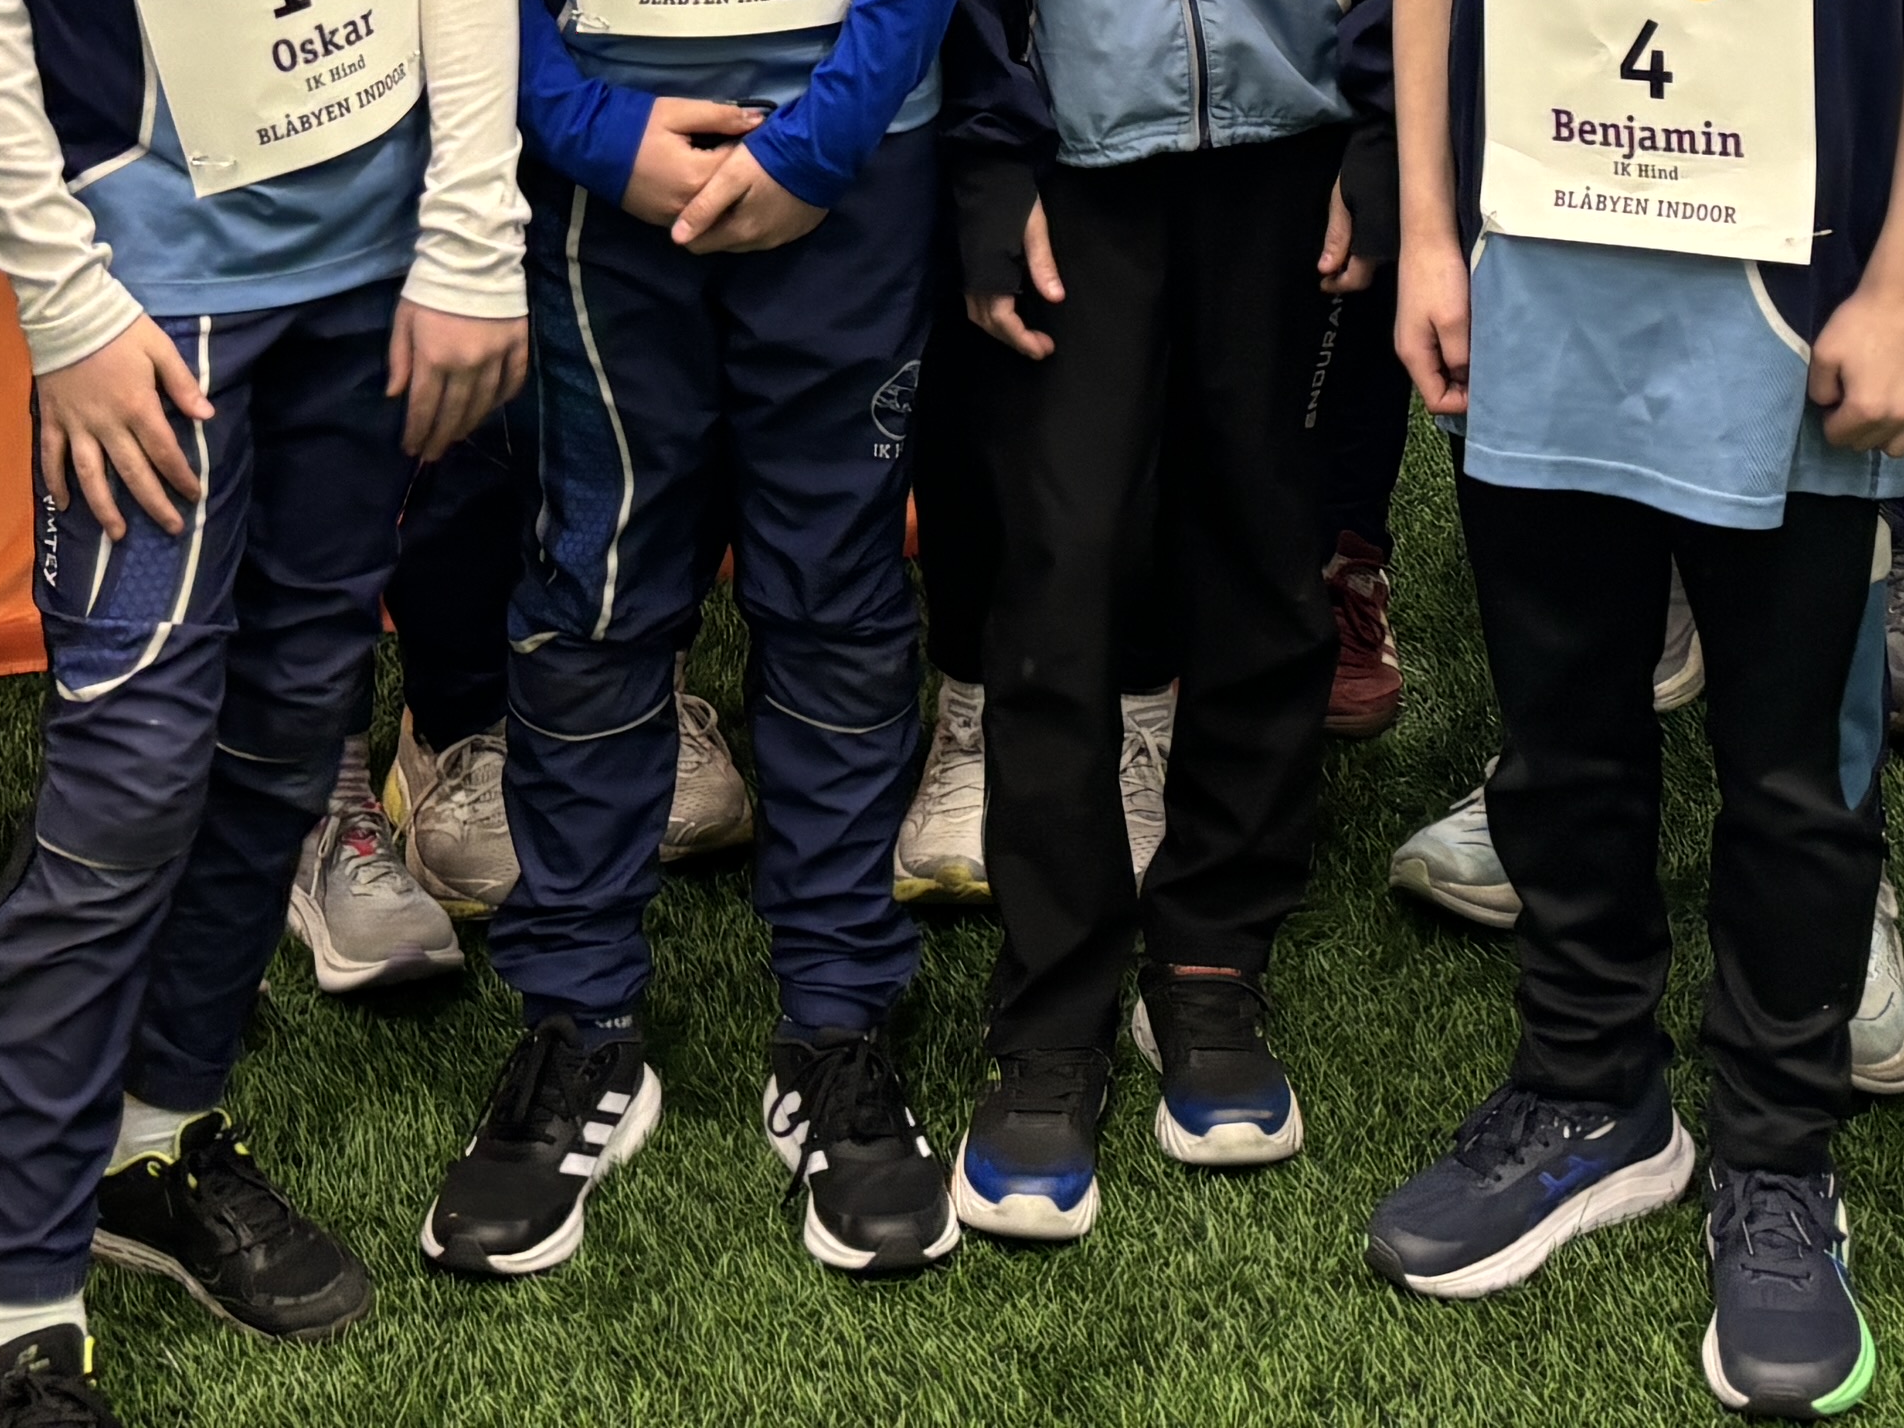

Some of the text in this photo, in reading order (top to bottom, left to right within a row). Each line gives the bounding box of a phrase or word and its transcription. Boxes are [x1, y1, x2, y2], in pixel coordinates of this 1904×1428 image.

[271, 7, 376, 74] Oskar
[1620, 19, 1673, 99] 4
[306, 53, 366, 93] IK Hind
[257, 62, 407, 147] BLÅBYEN INDOOR
[1551, 109, 1744, 159] Benjamin
[1613, 161, 1679, 180] IK Hind
[1554, 187, 1736, 224] BLÅBYEN INDOOR
